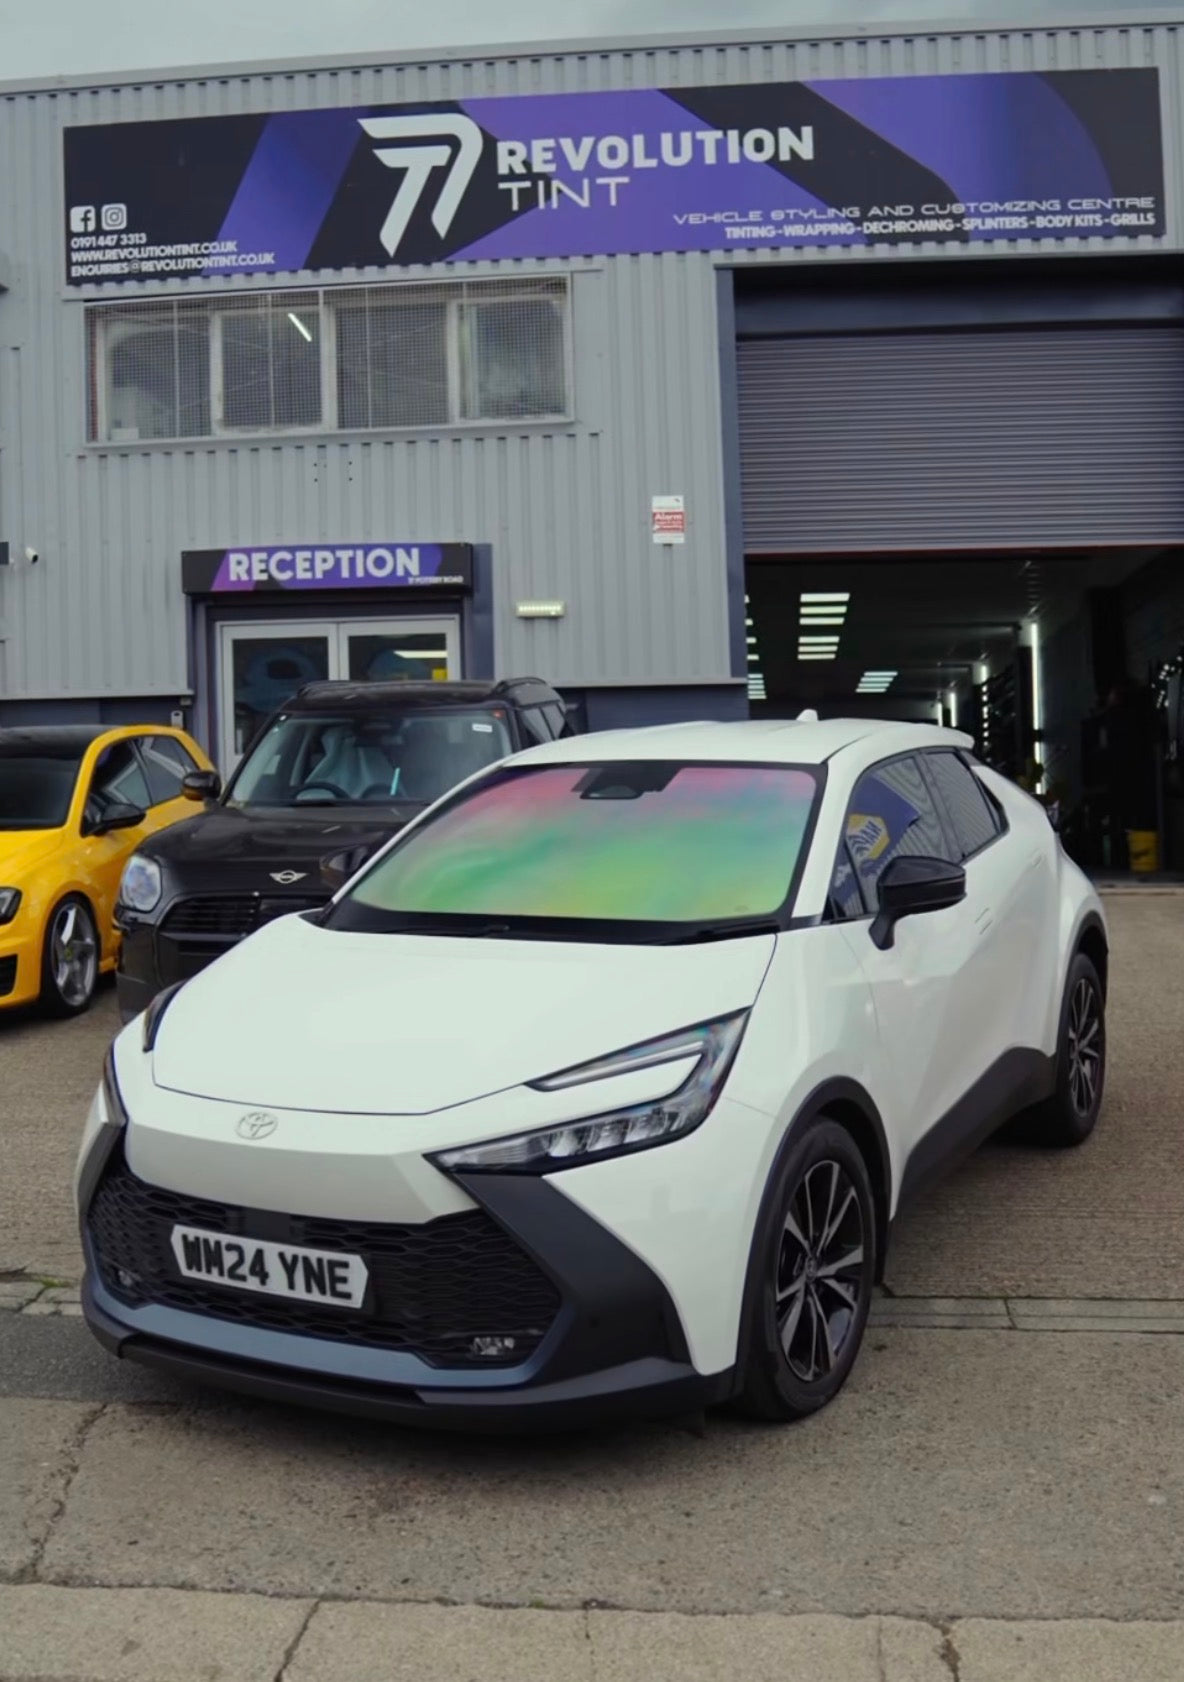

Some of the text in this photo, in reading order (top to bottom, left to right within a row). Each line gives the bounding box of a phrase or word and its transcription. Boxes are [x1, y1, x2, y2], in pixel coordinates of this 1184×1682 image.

[497, 126, 814, 175] REVOLUTION
[498, 176, 630, 211] TINT
[673, 197, 1154, 225] VEHICLE STYLING AND CUSTOMIZING CENTRE
[71, 233, 147, 249] 0191 447 3313
[229, 548, 420, 581] RECEPTION
[181, 1234, 352, 1300] WM24 YNE
